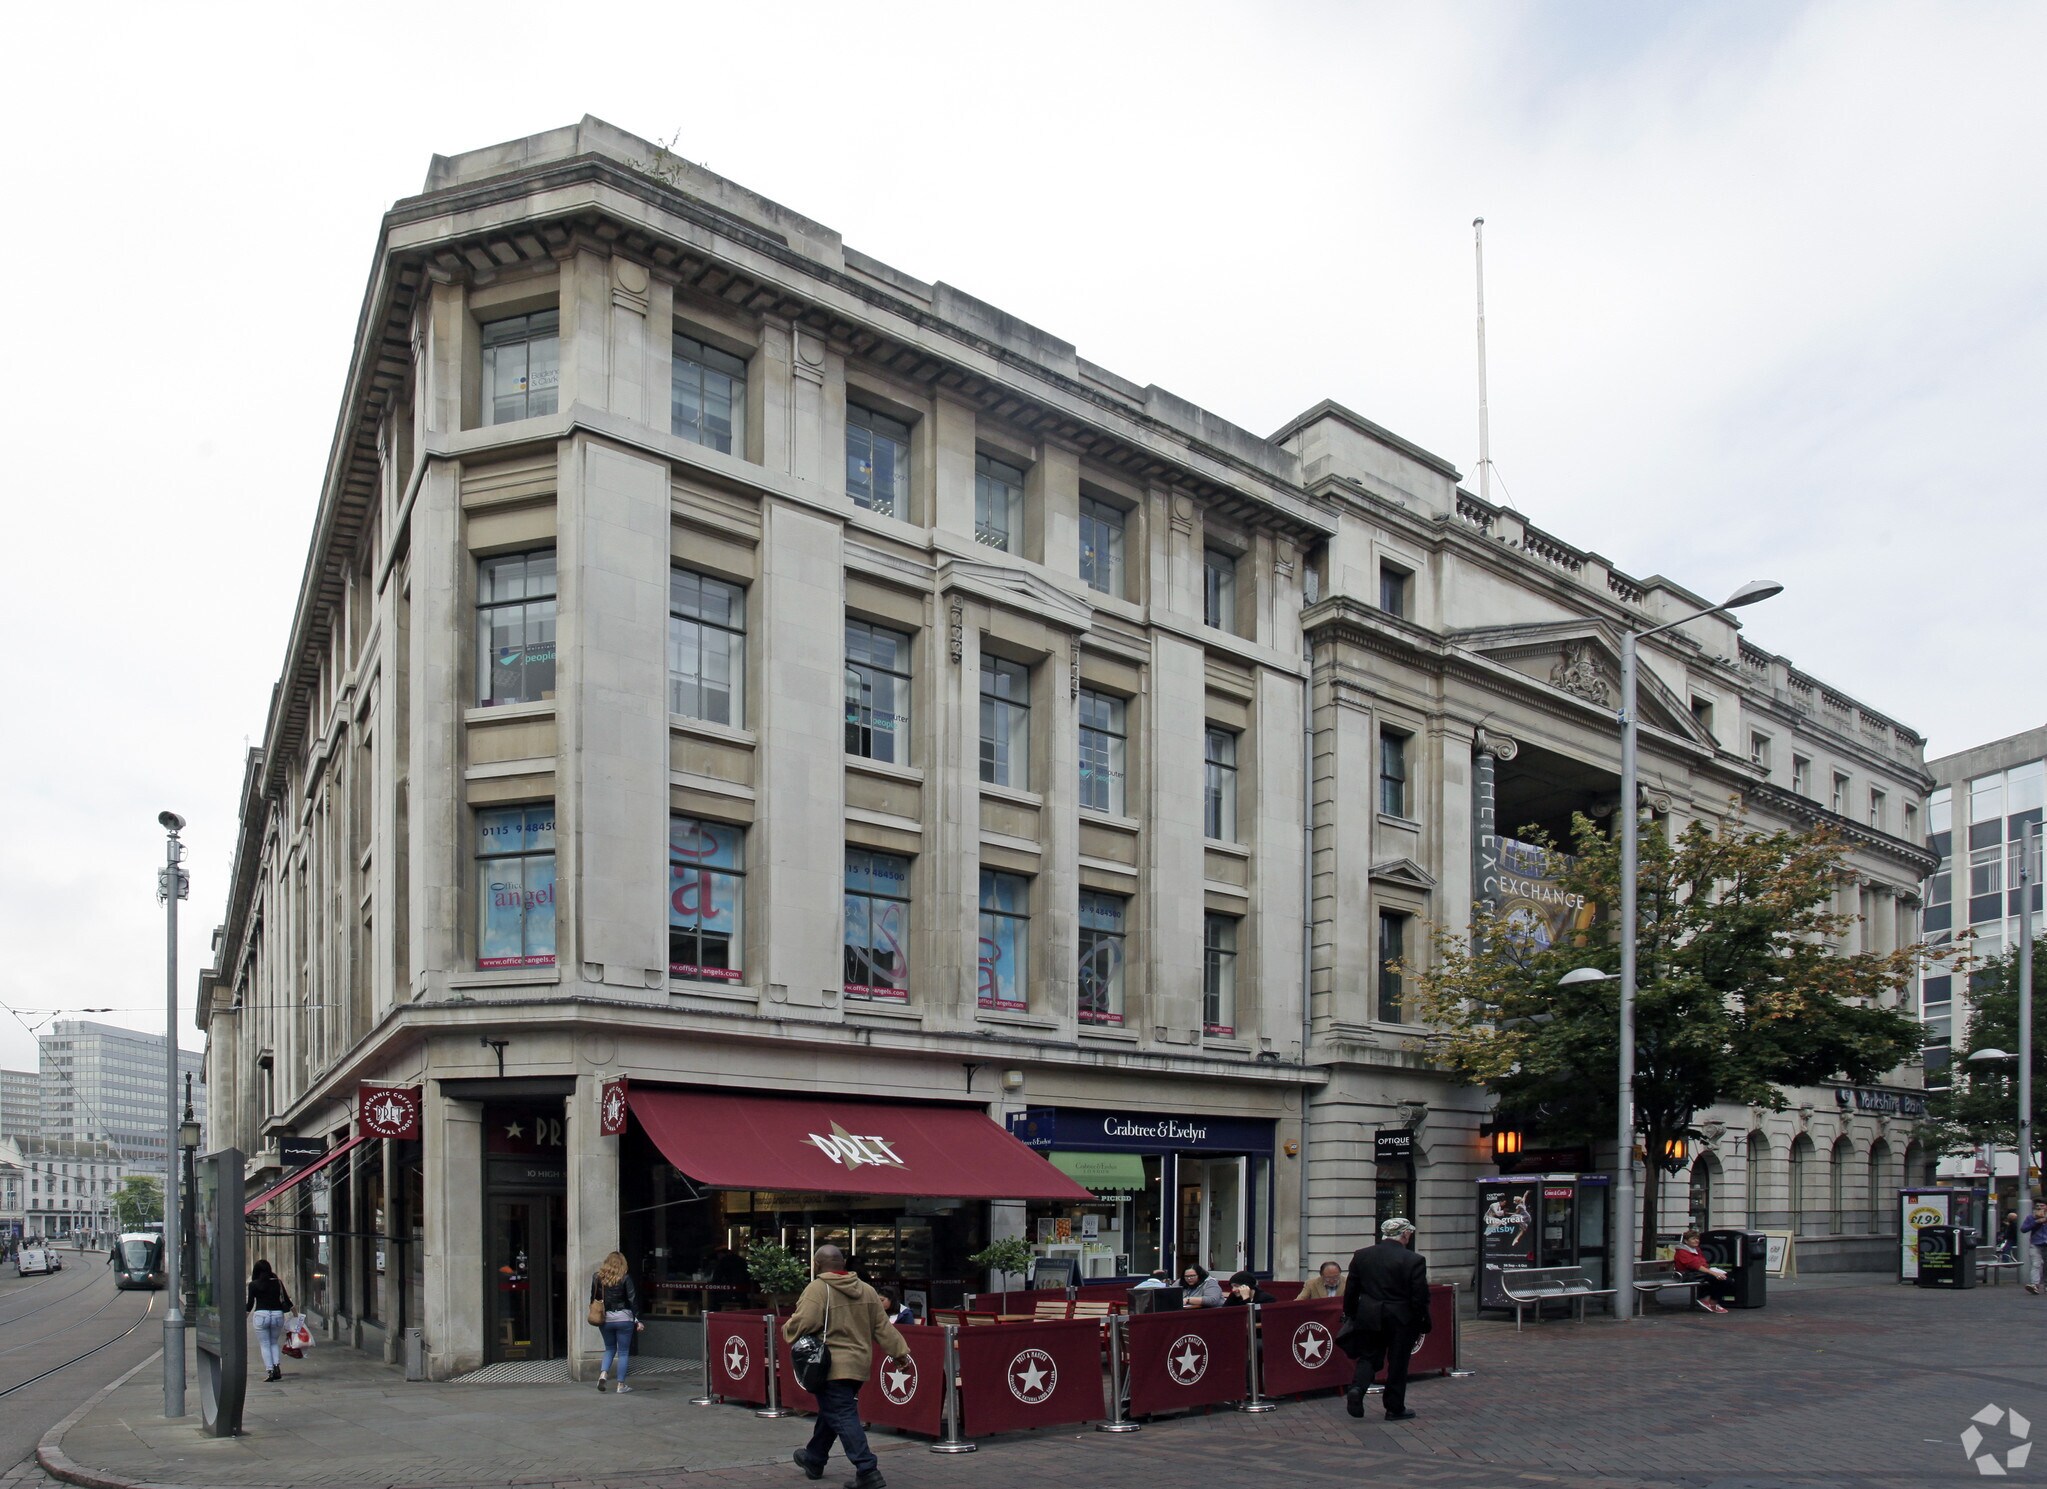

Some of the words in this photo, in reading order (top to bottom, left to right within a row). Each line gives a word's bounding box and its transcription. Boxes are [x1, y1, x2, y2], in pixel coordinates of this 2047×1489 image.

[525, 651, 556, 665] people
[482, 826, 509, 837] 0115
[1500, 876, 1585, 910] EXCHANGE
[364, 1091, 390, 1110] ORGANIC
[393, 1092, 414, 1113] COFFEE
[1861, 1090, 1899, 1110] Yorkshire
[376, 1104, 402, 1121] PRET
[366, 1117, 396, 1135] NATURAL
[397, 1119, 412, 1133] FOOD
[536, 1116, 567, 1147] PR
[1104, 1116, 1156, 1137] Crabtree
[1157, 1121, 1168, 1138] &
[1168, 1120, 1206, 1143] Evelyn
[808, 1133, 904, 1164] PRET
[1377, 1136, 1410, 1145] OPTIQUE
[1485, 1216, 1501, 1225] the
[1502, 1214, 1524, 1225] great
[1910, 1214, 1941, 1225] £1.99
